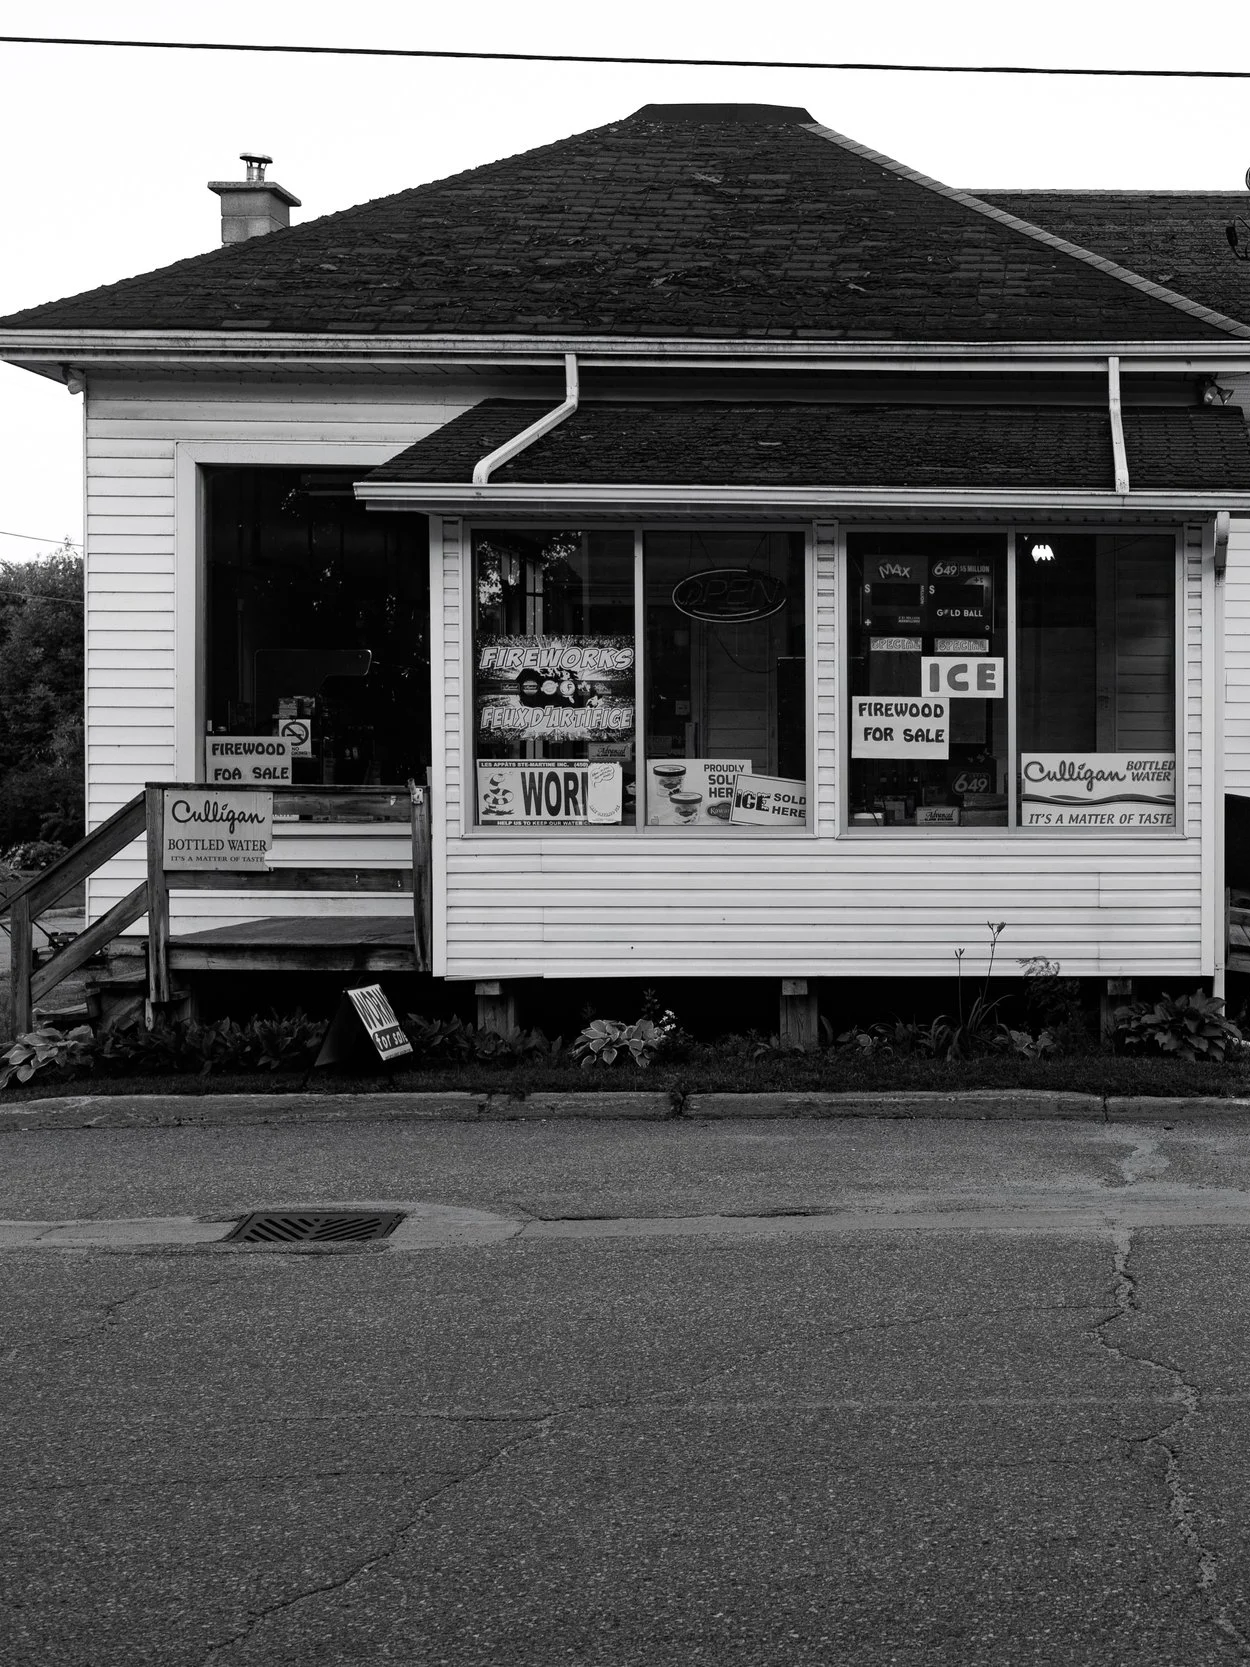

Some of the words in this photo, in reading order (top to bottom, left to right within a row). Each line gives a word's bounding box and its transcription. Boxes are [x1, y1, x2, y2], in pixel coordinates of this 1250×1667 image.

[879, 563, 911, 579] MAX
[934, 562, 957, 575] 649
[967, 565, 990, 573] MILLION
[676, 578, 780, 605] OPEN
[963, 609, 984, 617] BALL
[871, 638, 922, 650] SPECIAL
[938, 639, 986, 650] SPECIAL
[480, 647, 634, 671] FIREWORKS
[929, 663, 996, 692] ICE
[858, 702, 945, 718] FIREWOOD
[481, 707, 530, 730] FEUX
[529, 705, 633, 730] D'ARTIFICE
[863, 727, 894, 741] FOR
[903, 728, 945, 743] SALE
[212, 743, 286, 756] FIREWOOD
[704, 764, 745, 773] PROUDLY
[1126, 760, 1175, 771] BOTTLED
[252, 767, 289, 780] SALE
[1023, 760, 1126, 792] Culligan
[1131, 771, 1171, 781] WATER
[954, 773, 988, 792] 649
[709, 787, 733, 798] HER
[735, 789, 771, 812] ICE
[773, 793, 806, 806] SOLD
[172, 799, 265, 834] Culligan
[772, 805, 806, 818] HERE
[1028, 813, 1052, 824] IT'S
[1055, 813, 1064, 824] A
[1068, 813, 1115, 824] MATTER
[1119, 813, 1135, 824] OF
[1138, 813, 1173, 824] TASTE
[168, 838, 225, 851] BOTTLED
[228, 839, 268, 851] WATER
[375, 1033, 391, 1050] for
